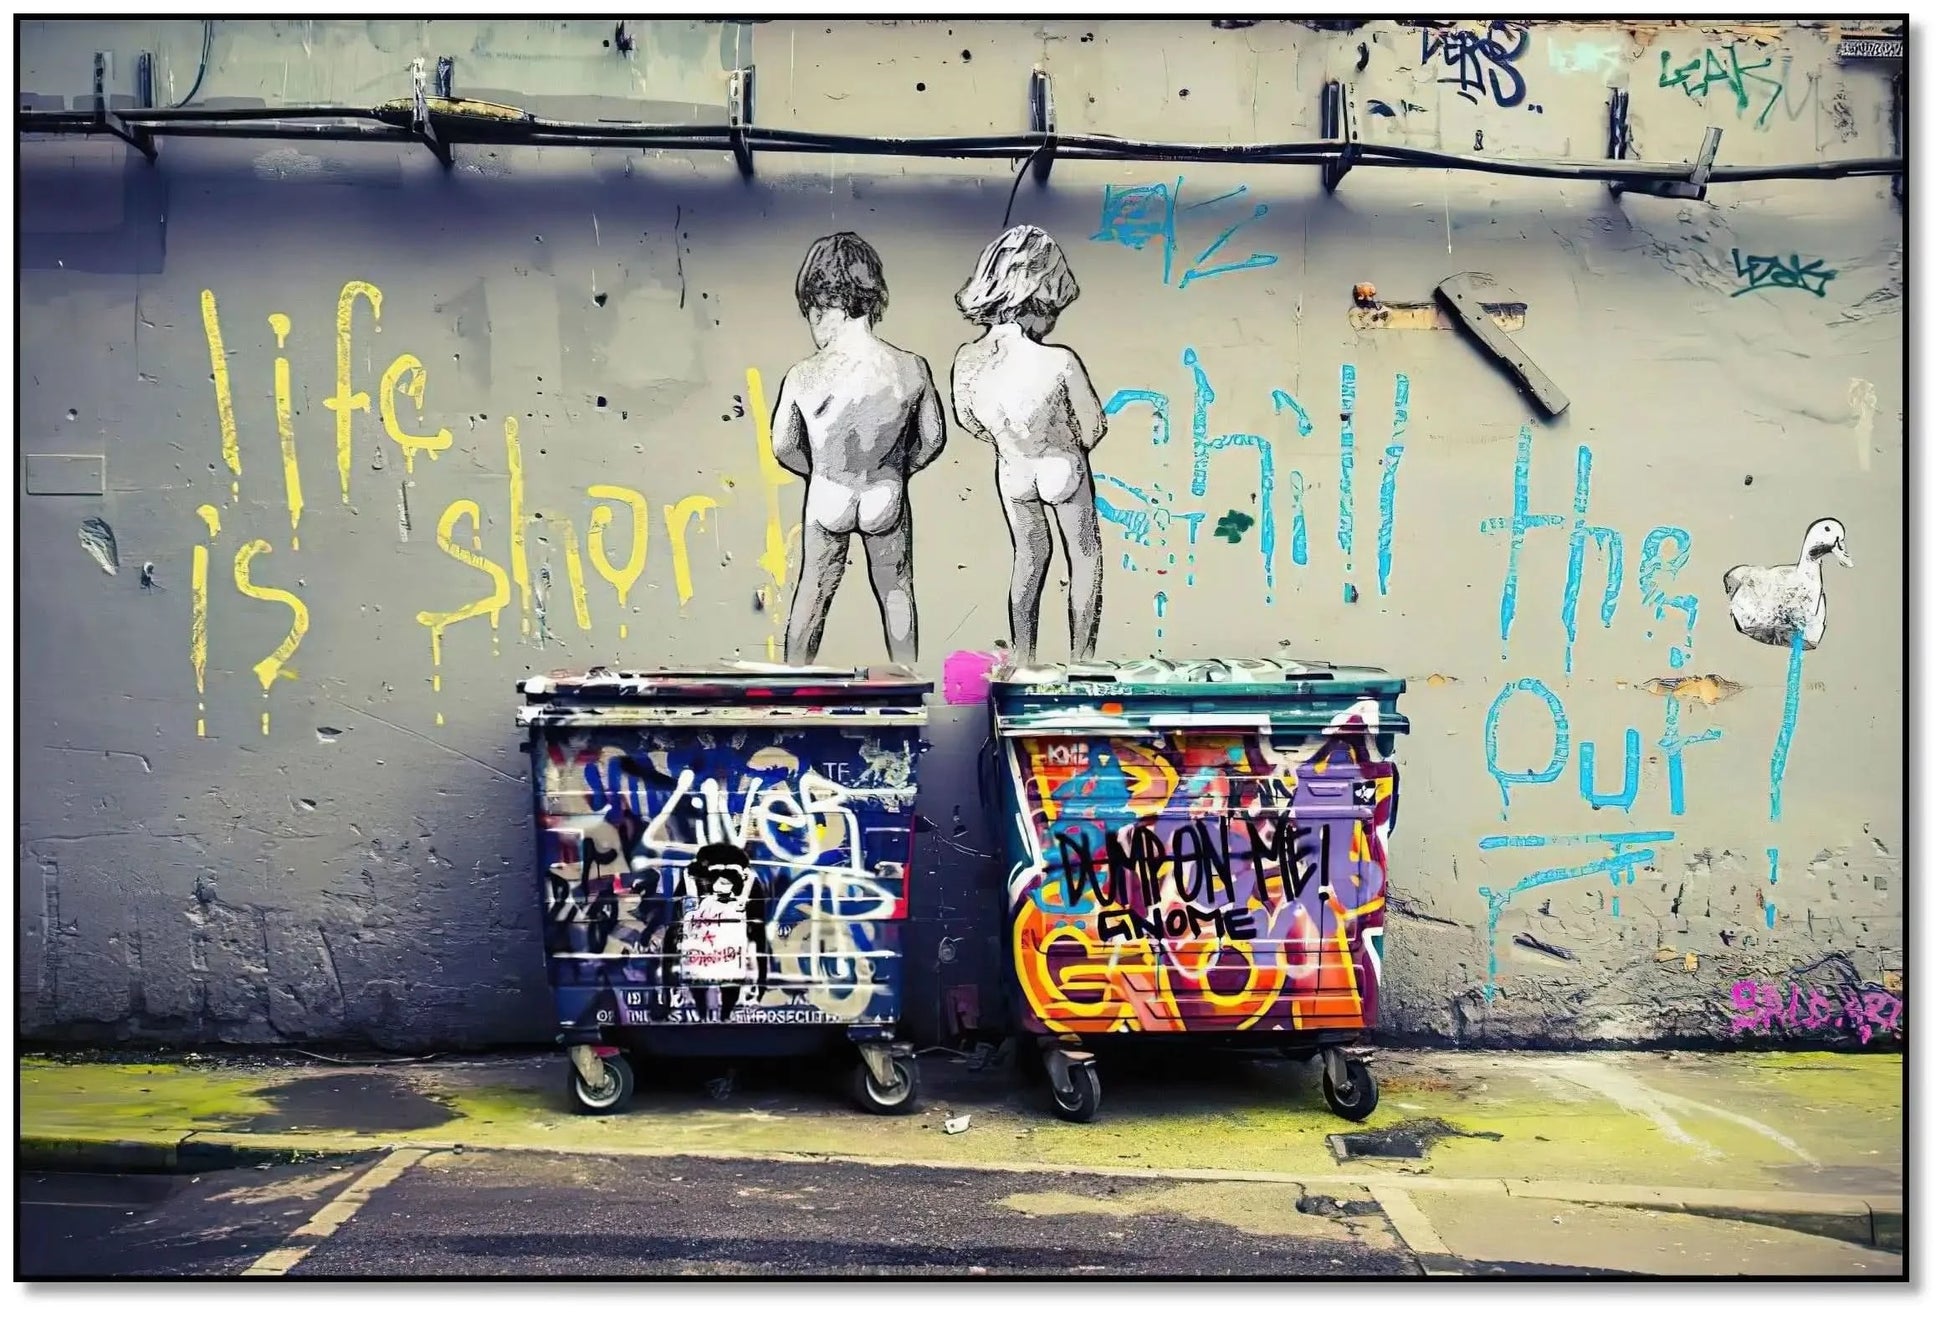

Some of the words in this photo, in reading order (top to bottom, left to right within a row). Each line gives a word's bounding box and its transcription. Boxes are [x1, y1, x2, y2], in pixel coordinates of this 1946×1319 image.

[200, 280, 453, 540] life
[190, 504, 311, 700] is
[1098, 905, 1257, 942] GNOME
[1172, 815, 1236, 904] ON
